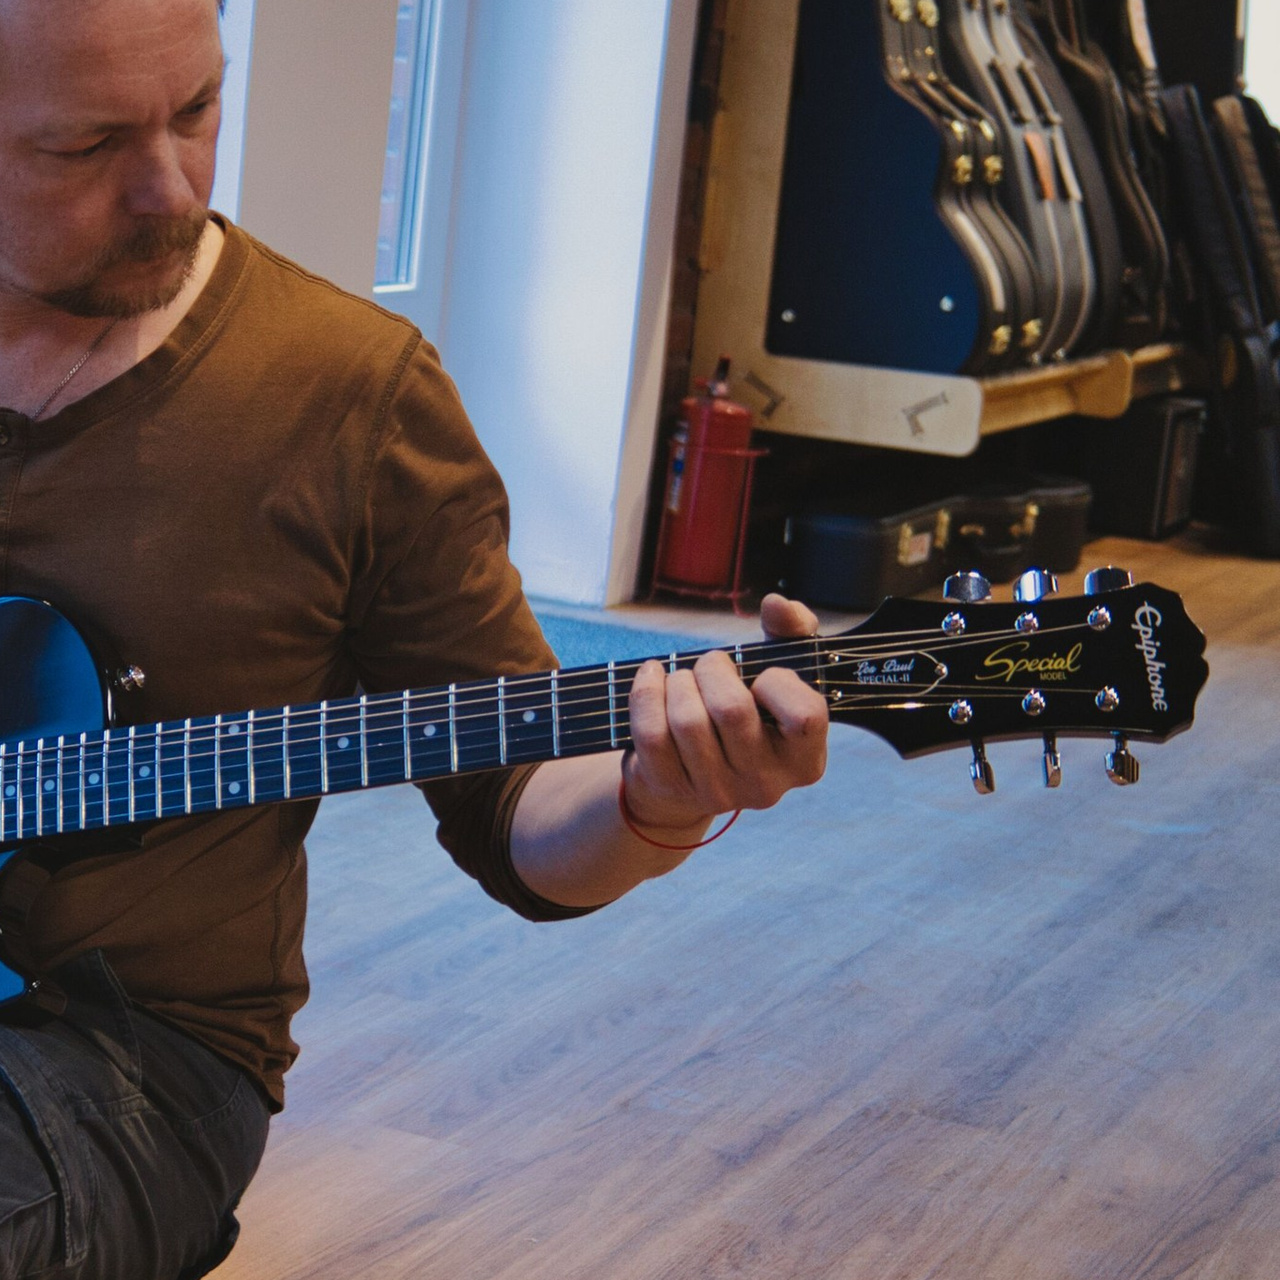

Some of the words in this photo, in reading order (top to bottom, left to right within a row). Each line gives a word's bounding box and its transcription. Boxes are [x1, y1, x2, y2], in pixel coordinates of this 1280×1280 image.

[975, 641, 1083, 683] Special
[1039, 672, 1067, 681] MODEL
[1131, 600, 1168, 713] Epiphone
